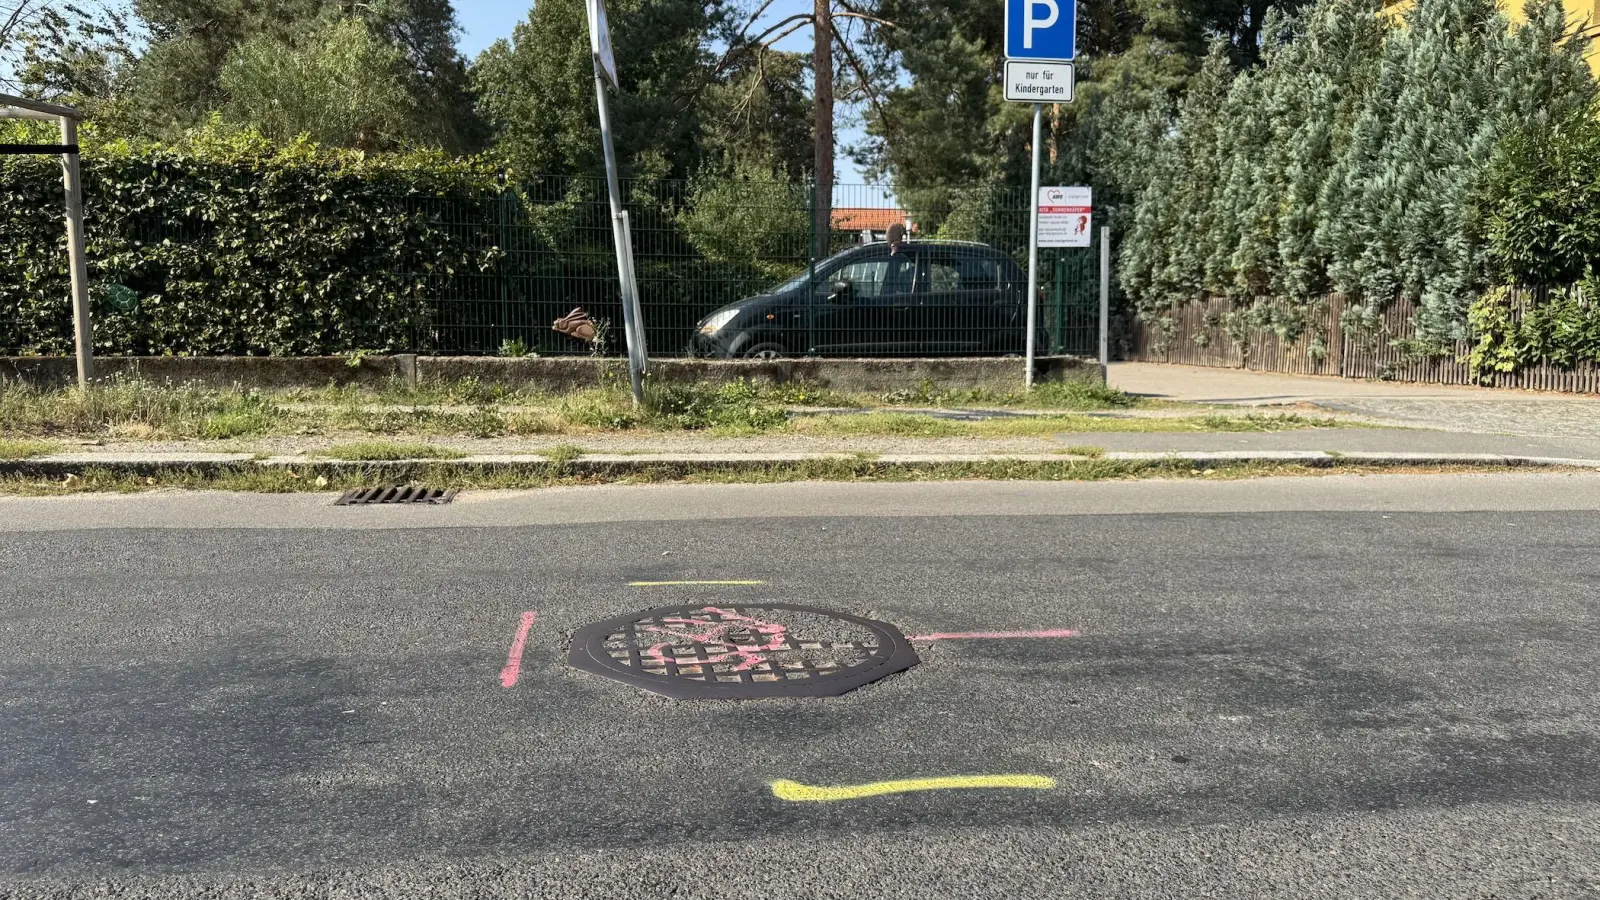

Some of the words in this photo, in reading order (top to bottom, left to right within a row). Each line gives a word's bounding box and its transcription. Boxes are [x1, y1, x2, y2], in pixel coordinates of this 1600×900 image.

[1023, 0, 1060, 49] P
[1026, 71, 1039, 80] nur
[1043, 70, 1054, 80] für
[1015, 83, 1064, 96] Kindergarten
